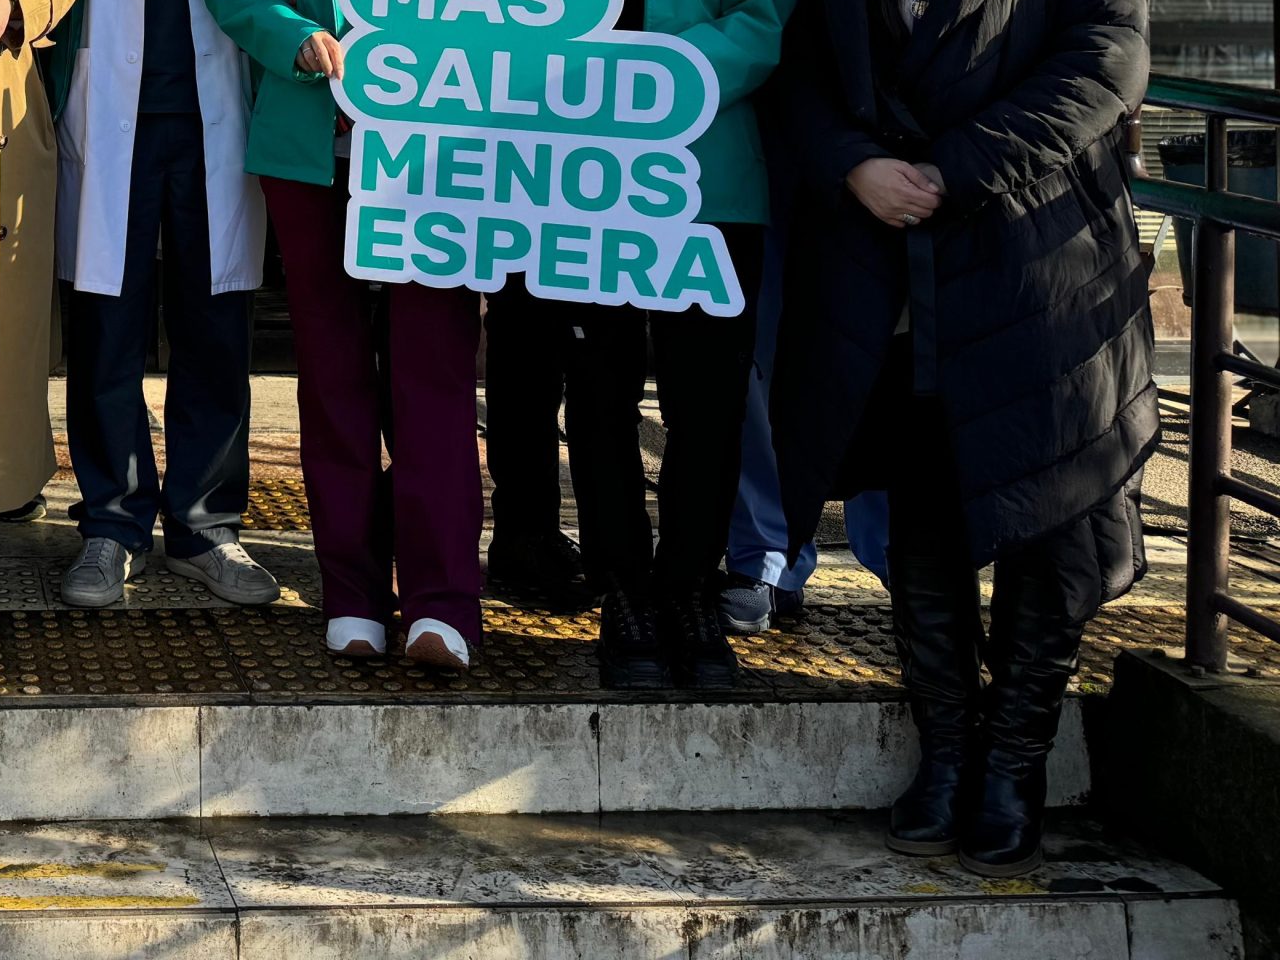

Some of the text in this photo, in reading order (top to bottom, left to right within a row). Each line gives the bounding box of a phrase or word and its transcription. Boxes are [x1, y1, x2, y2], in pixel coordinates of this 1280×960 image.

[363, 43, 676, 124] SALUD
[360, 130, 688, 217] MENOS
[355, 205, 731, 305] ESPERA
